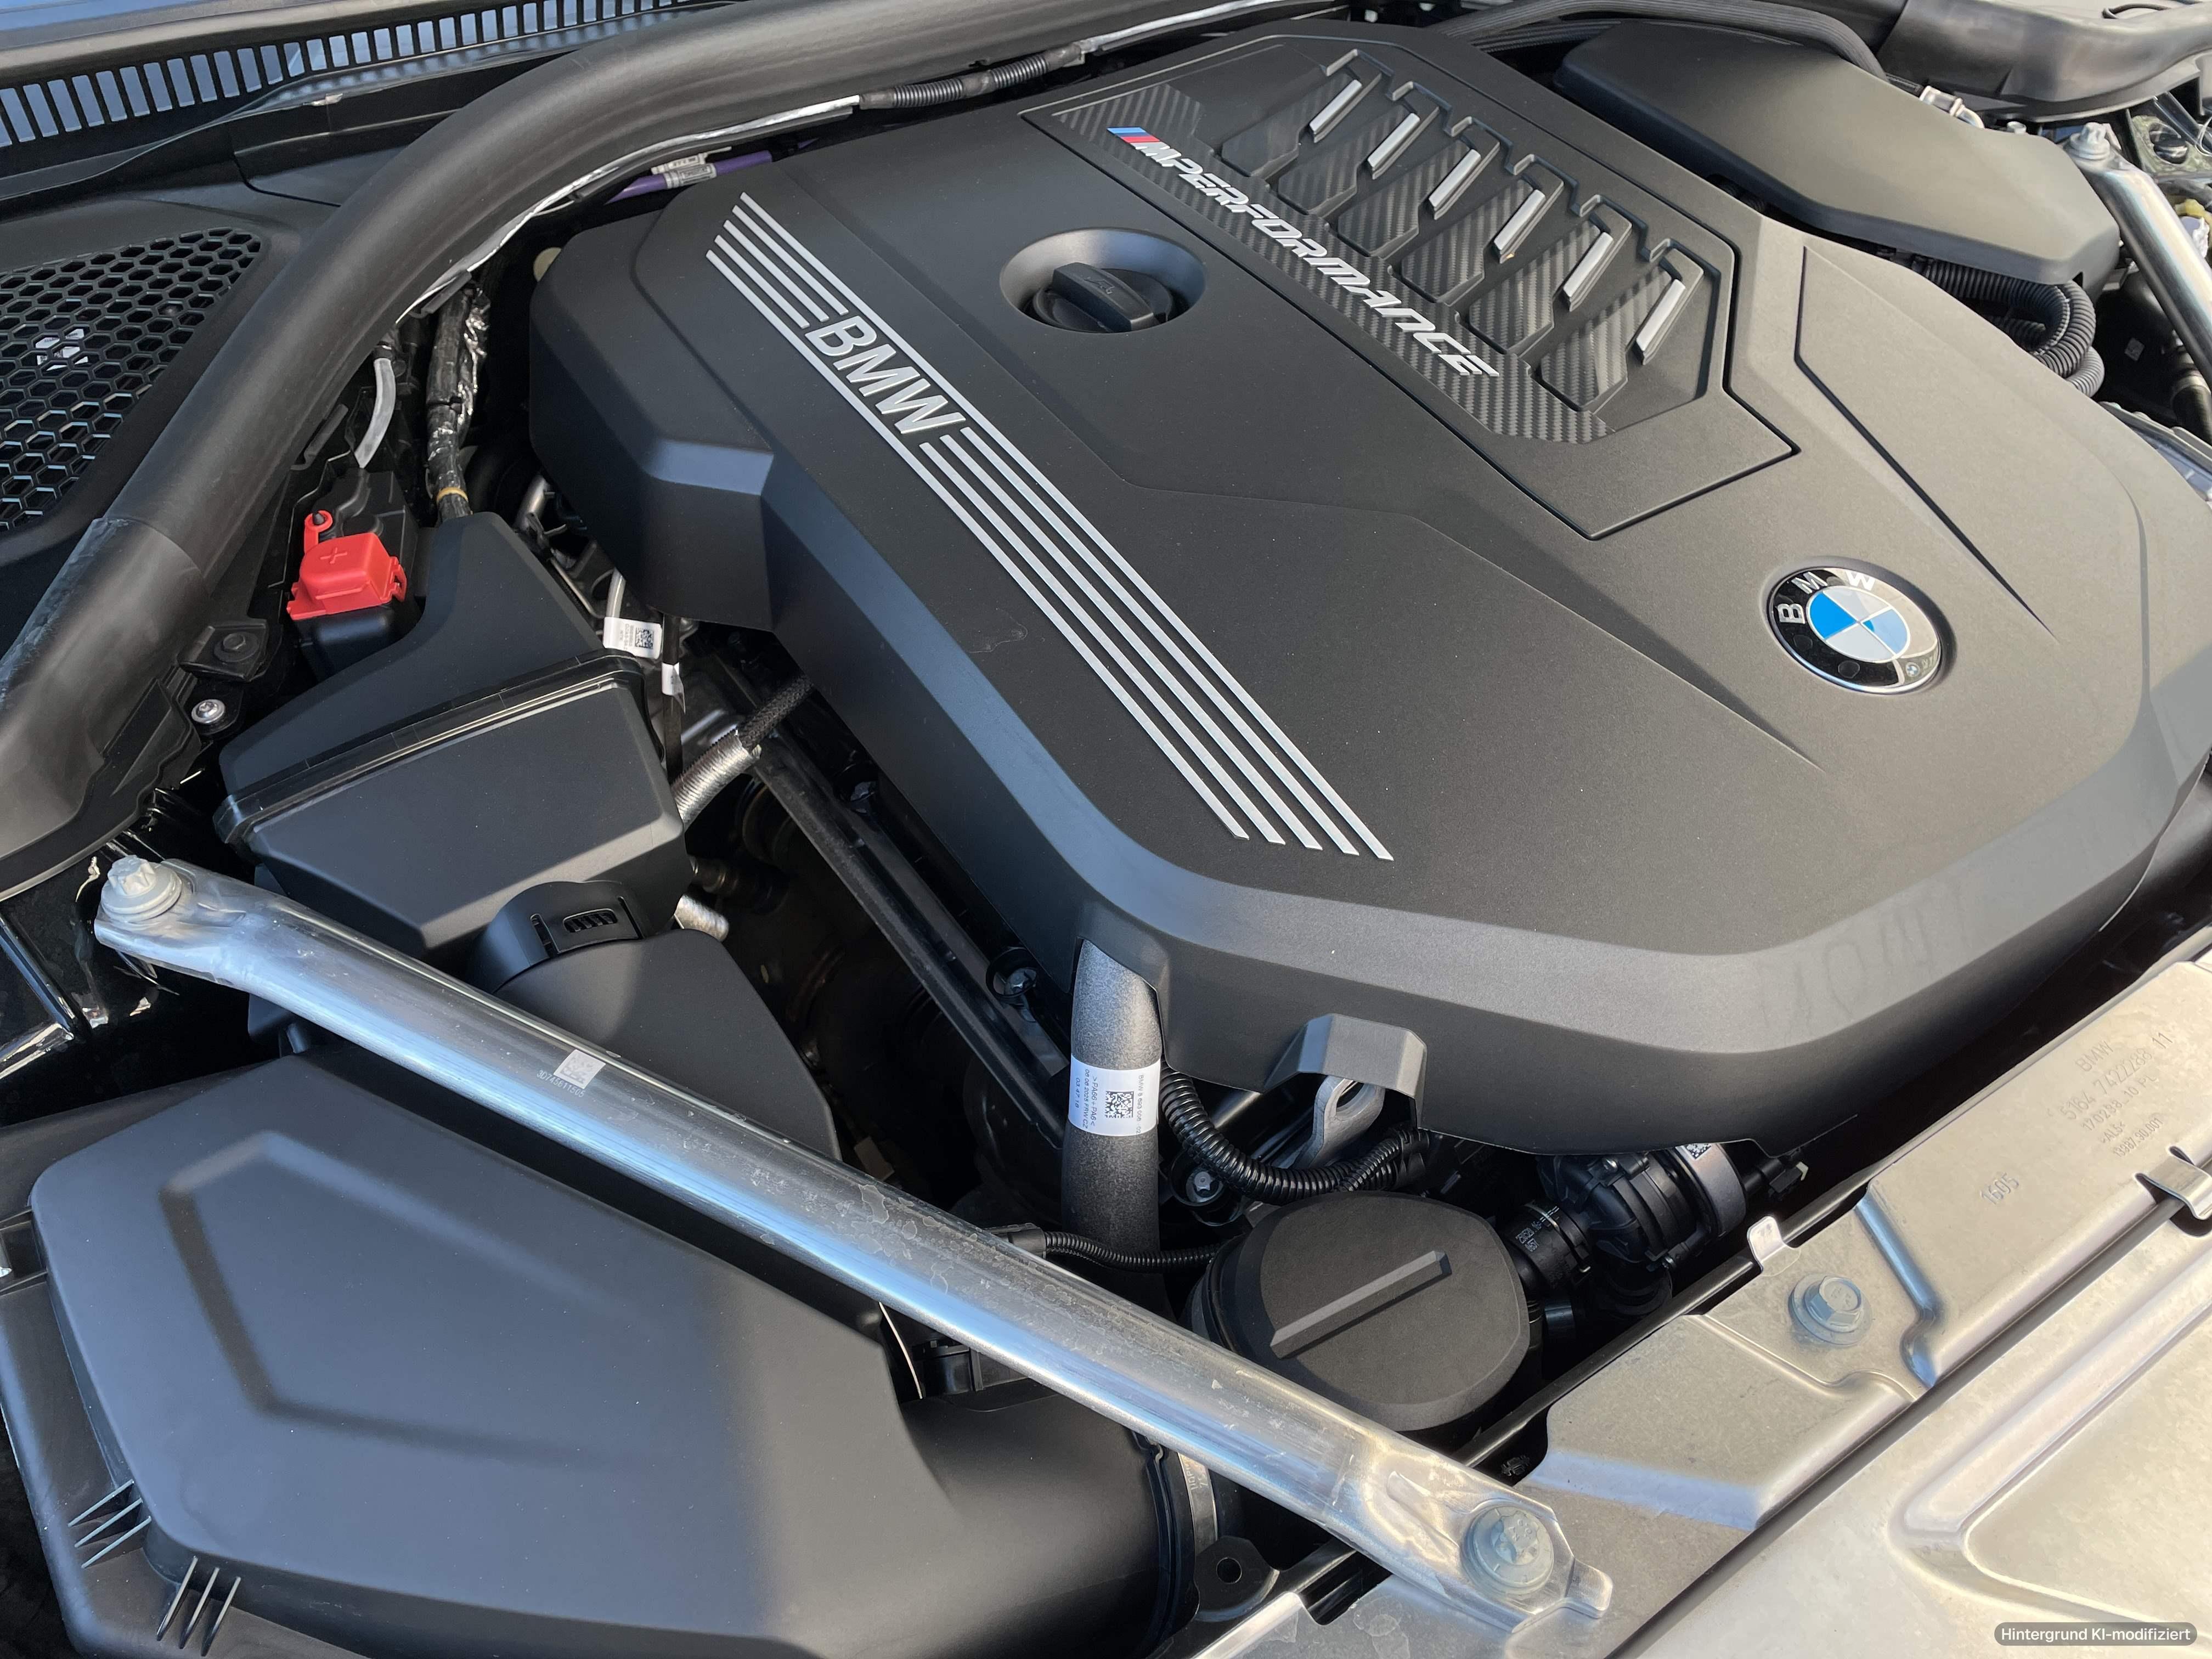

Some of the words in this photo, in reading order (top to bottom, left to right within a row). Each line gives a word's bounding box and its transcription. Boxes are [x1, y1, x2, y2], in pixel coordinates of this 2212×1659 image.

[804, 315, 966, 435] BMW
[1776, 571, 1876, 624] BMW
[2075, 1040, 2113, 1072] BMW
[2060, 1091, 2096, 1120] 5164
